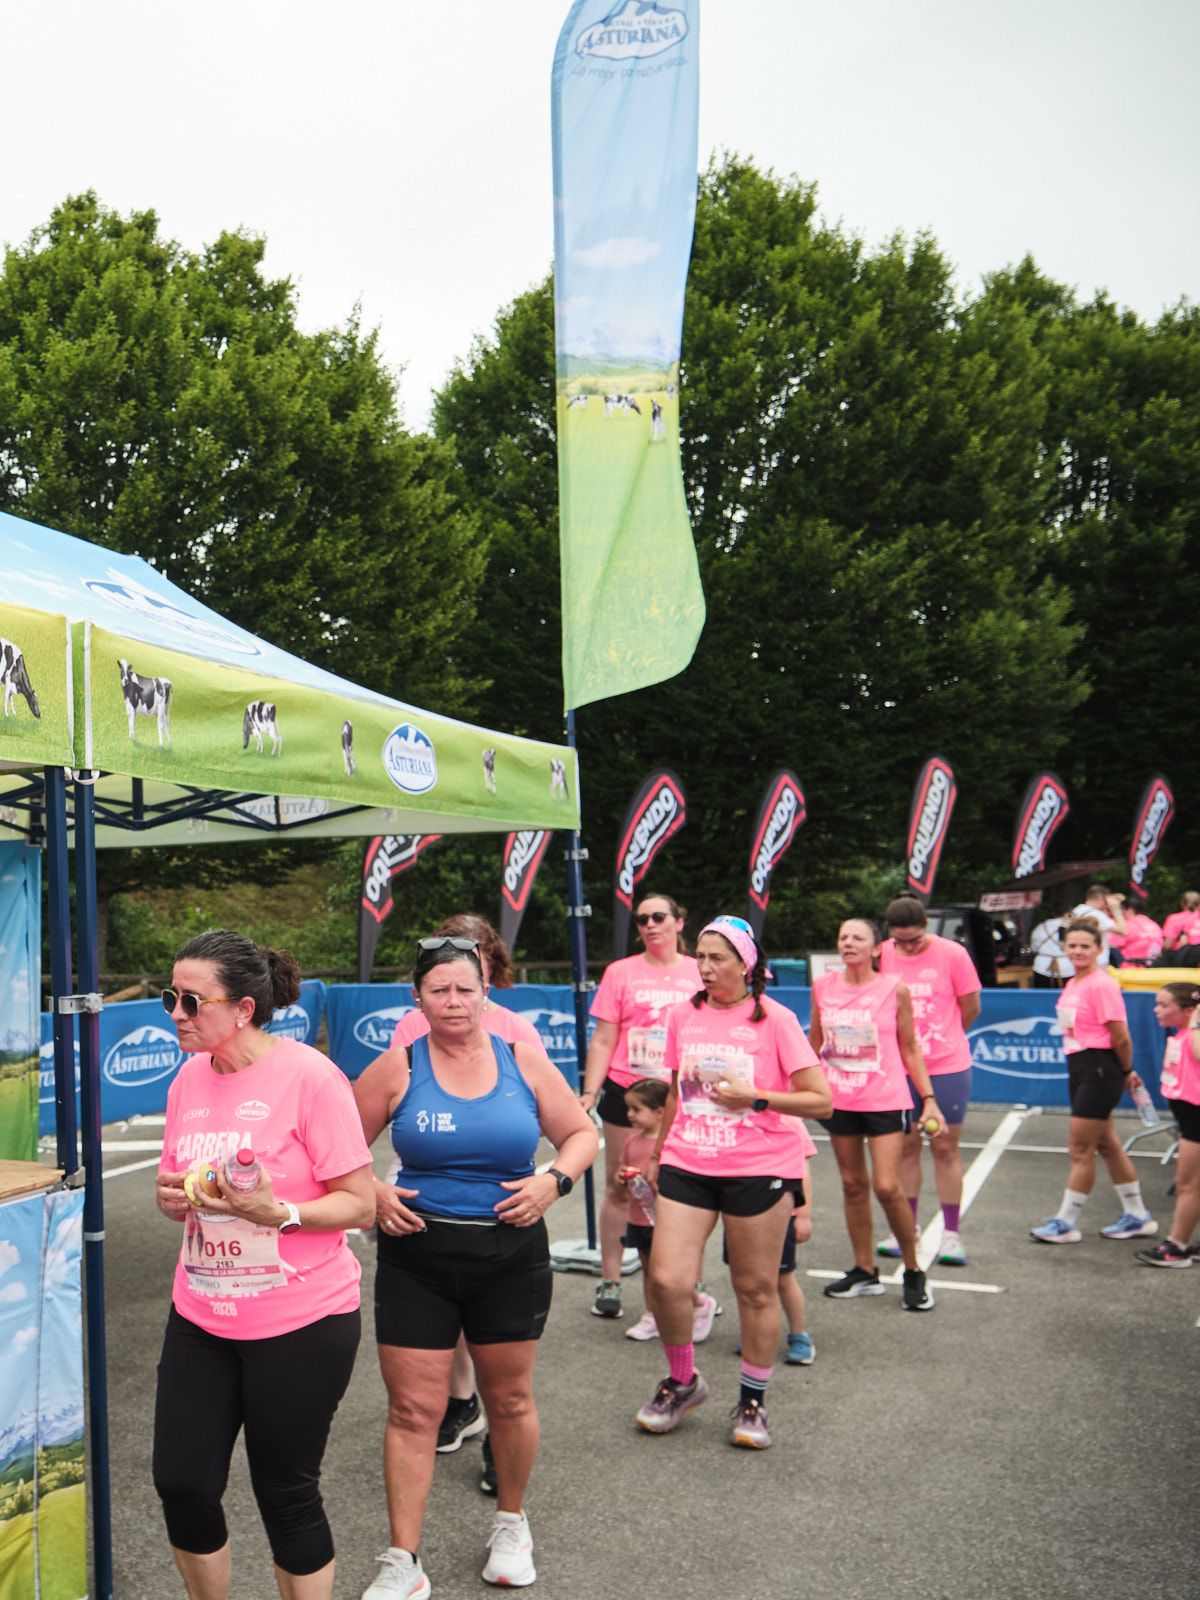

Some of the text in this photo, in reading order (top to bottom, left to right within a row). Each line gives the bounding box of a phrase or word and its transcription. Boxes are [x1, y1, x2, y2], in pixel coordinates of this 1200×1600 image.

[908, 769, 947, 879] OQUENDO
[111, 1050, 177, 1075] ASTURIANA
[177, 1131, 252, 1163] CARRERA
[204, 1240, 242, 1257] 016
[216, 1260, 234, 1269] 2183
